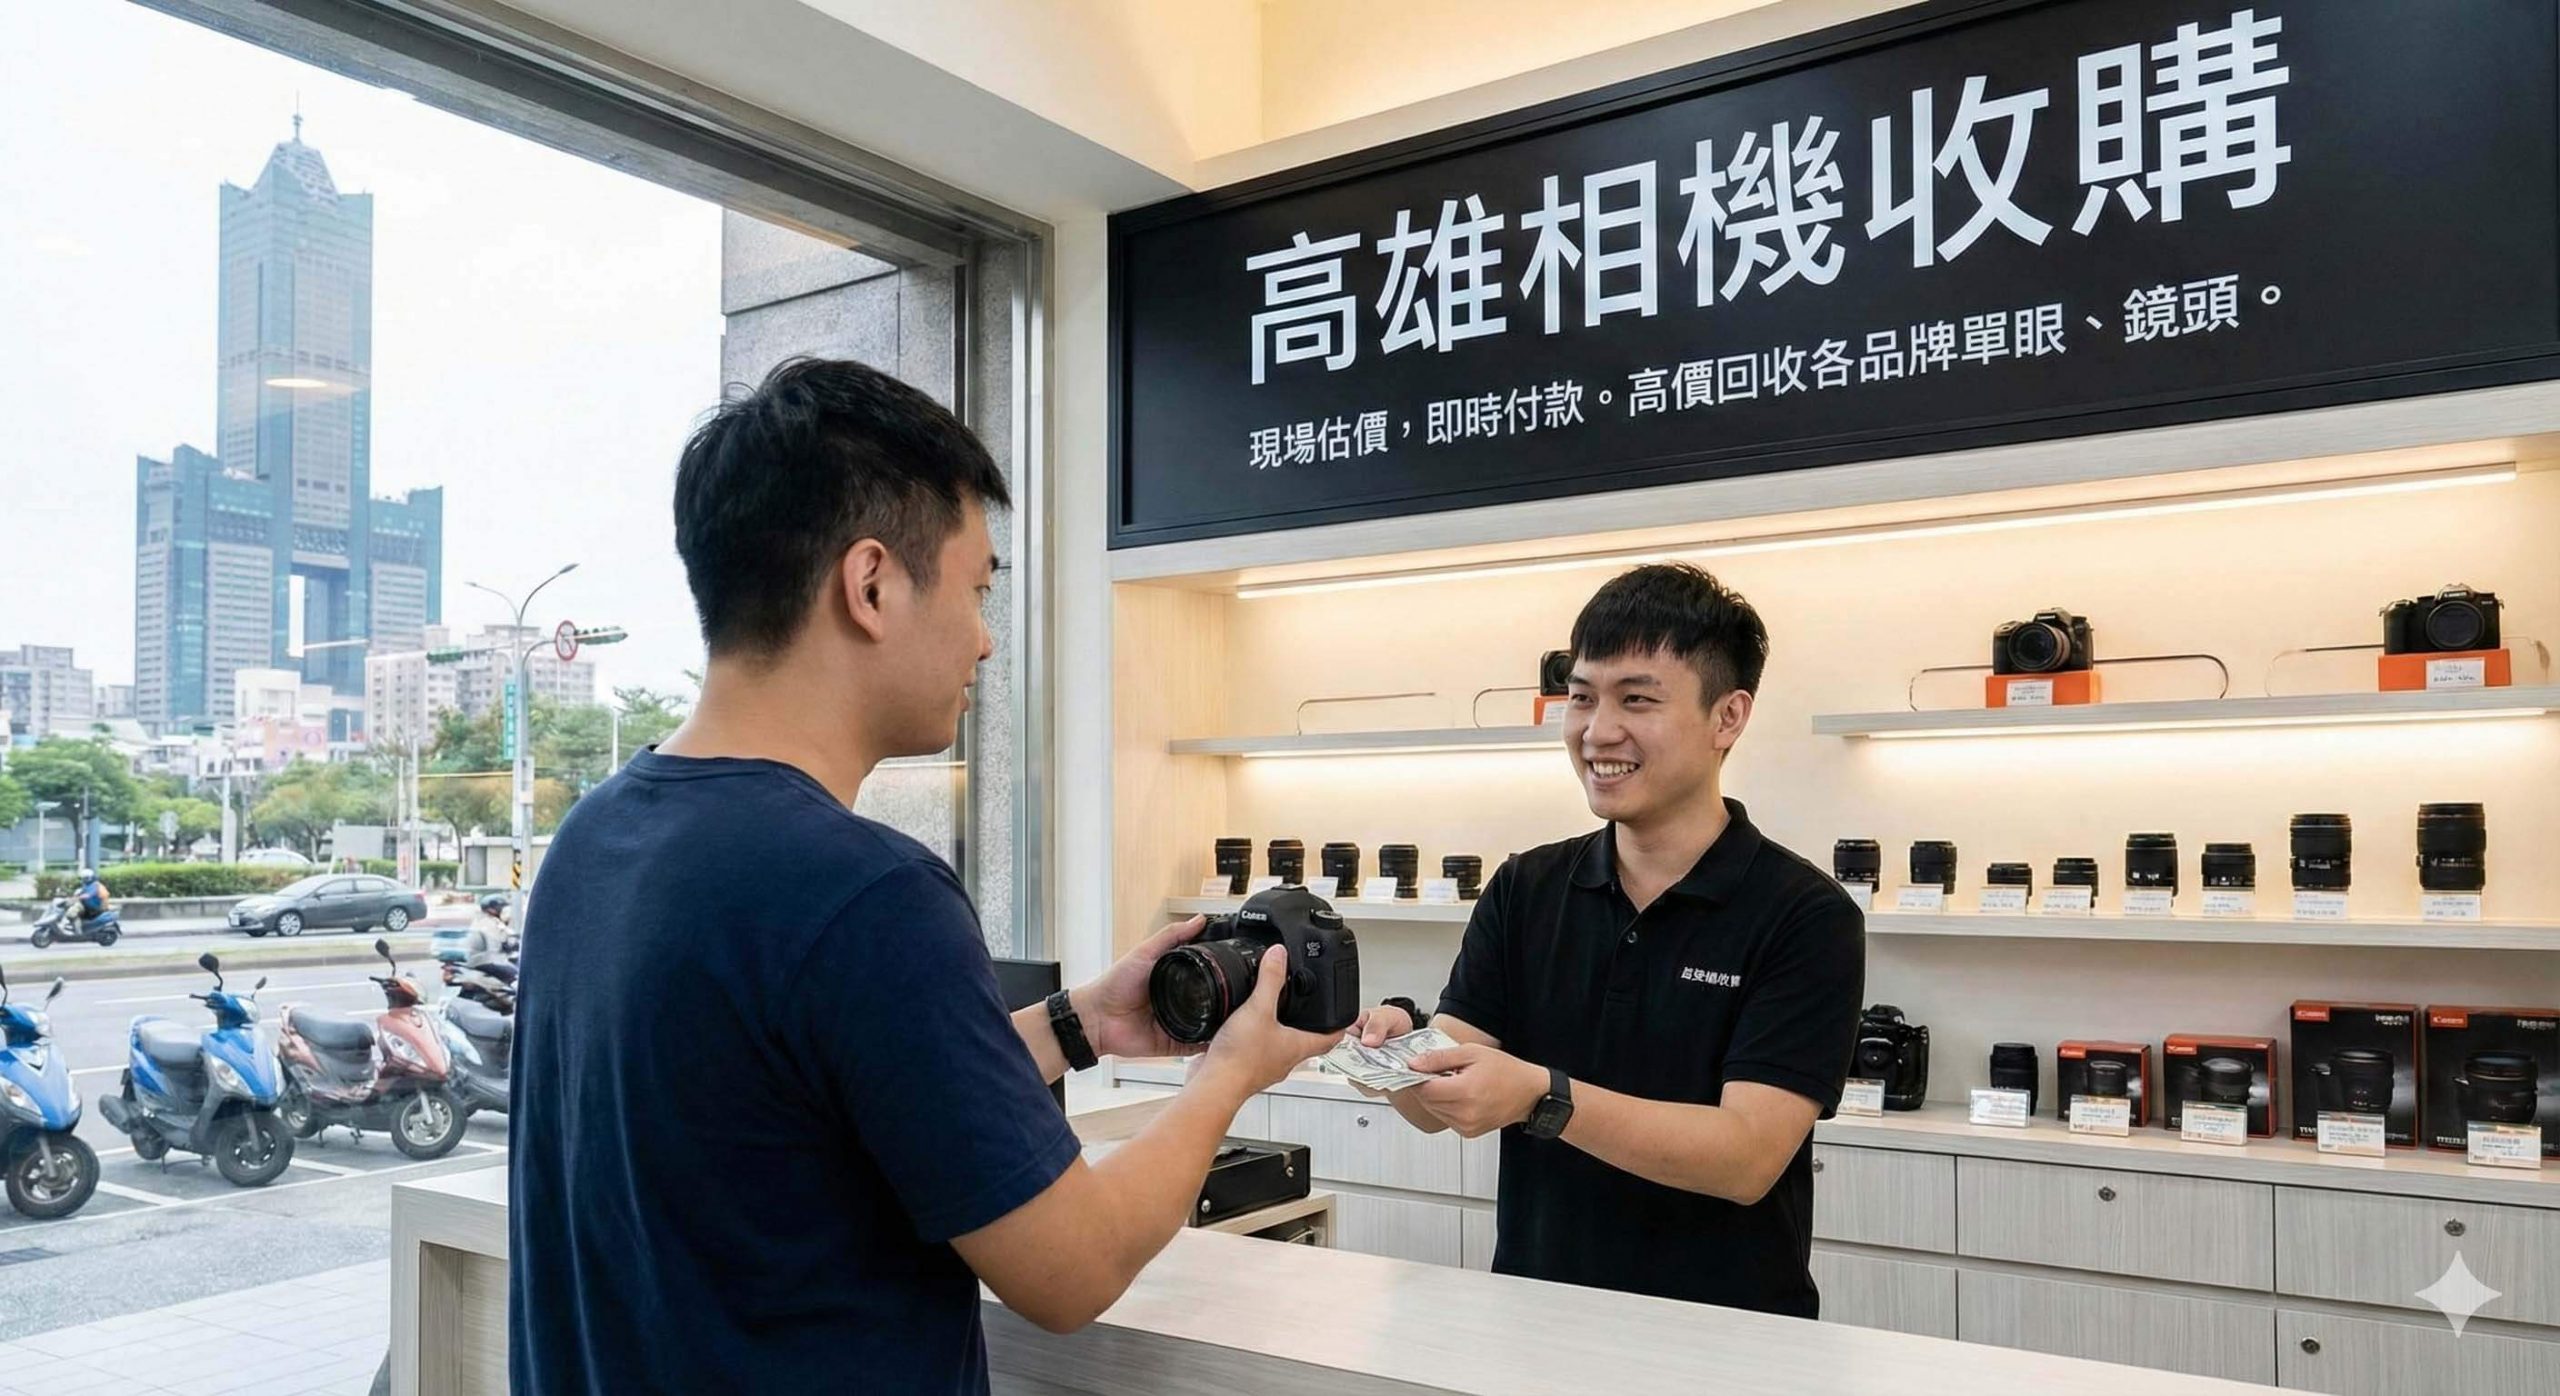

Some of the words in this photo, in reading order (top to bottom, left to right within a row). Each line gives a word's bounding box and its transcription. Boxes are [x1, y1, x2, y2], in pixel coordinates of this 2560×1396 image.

[1247, 9, 2292, 385] 高雄相機收購
